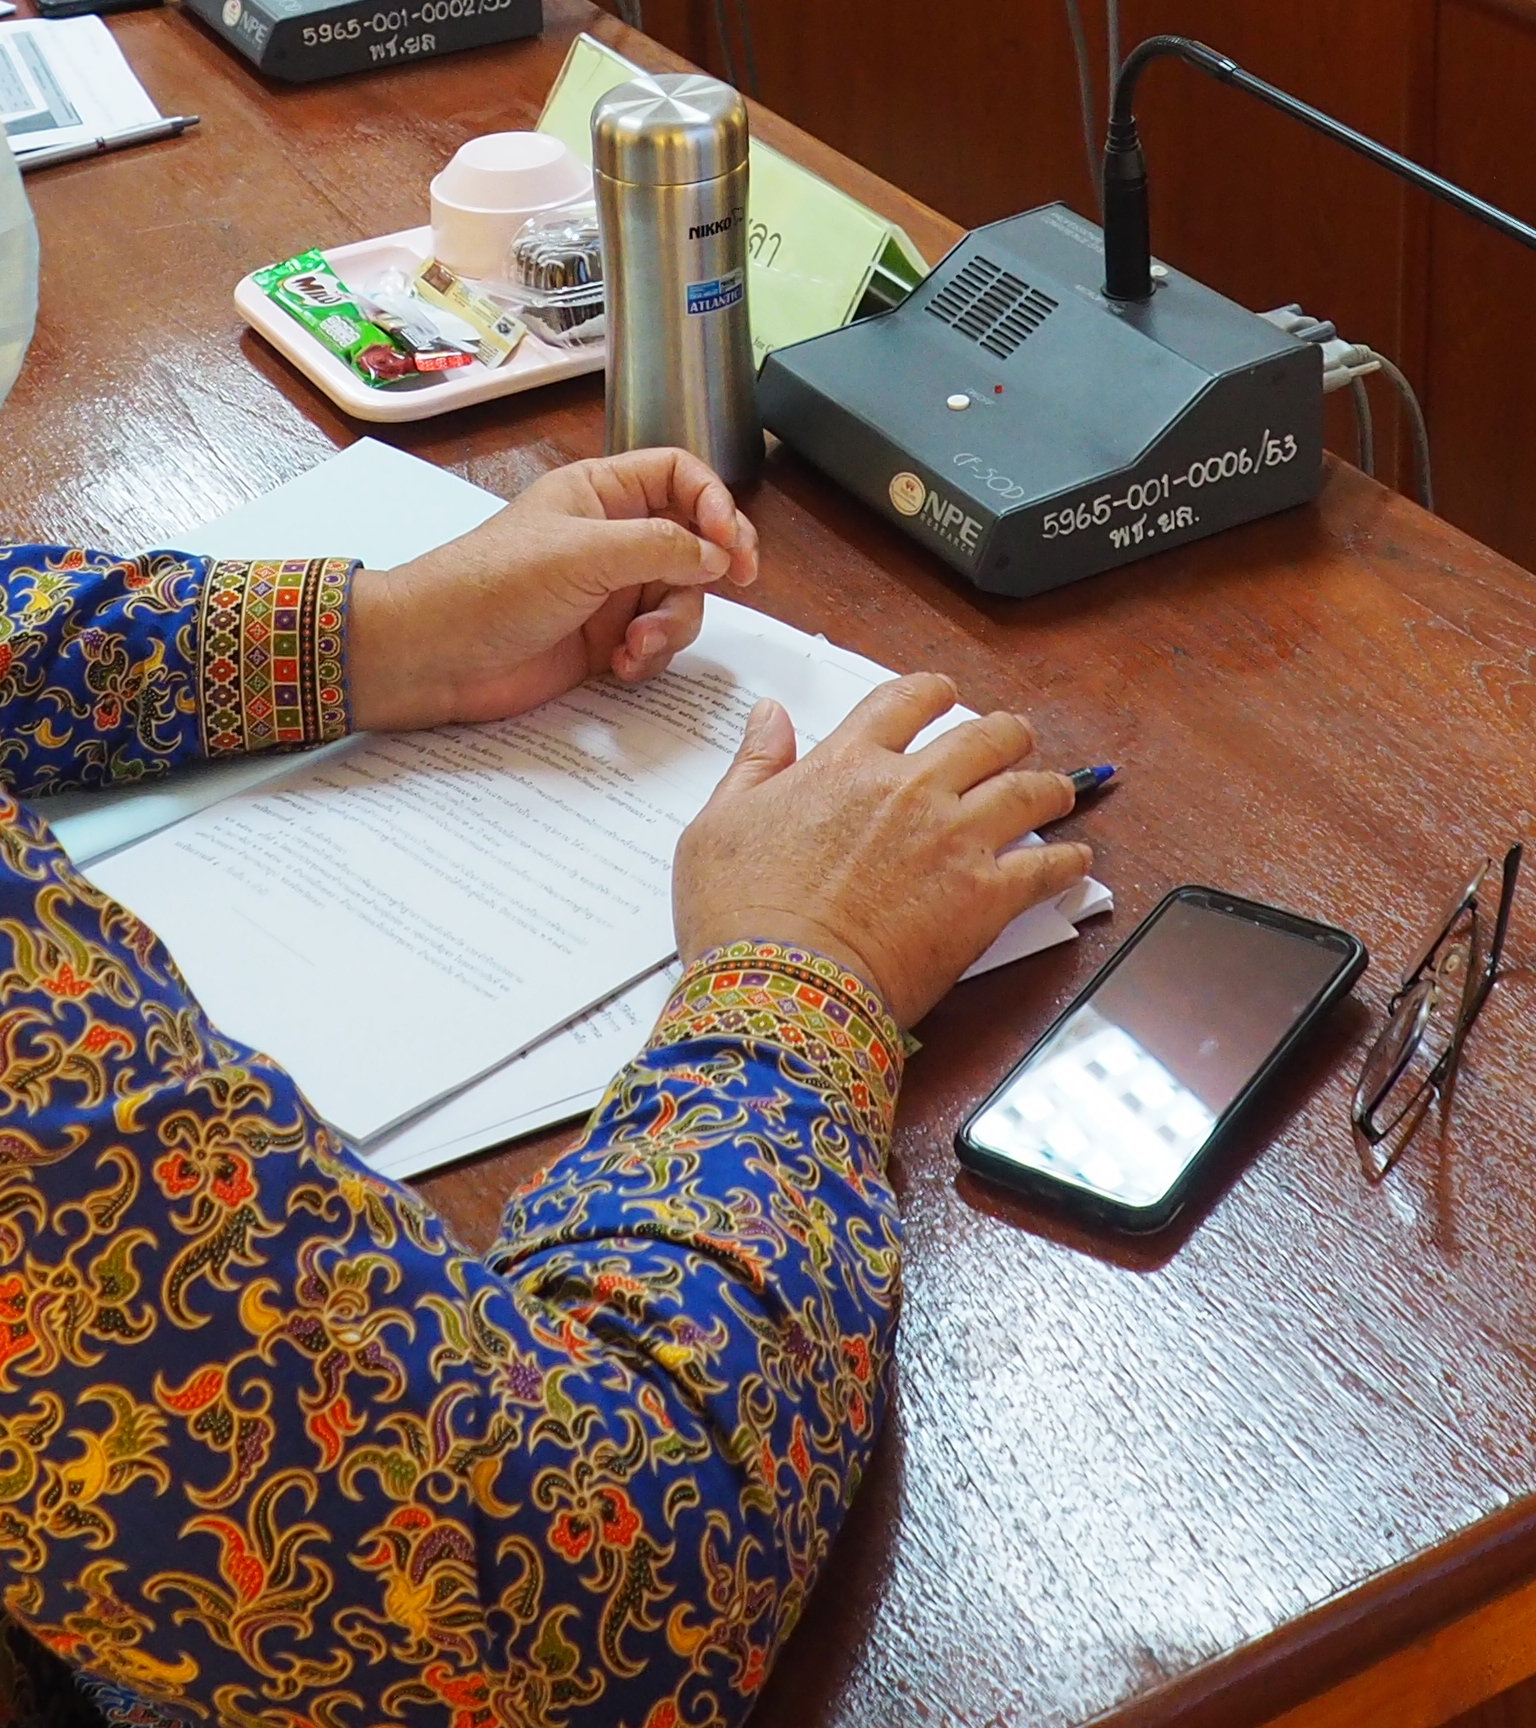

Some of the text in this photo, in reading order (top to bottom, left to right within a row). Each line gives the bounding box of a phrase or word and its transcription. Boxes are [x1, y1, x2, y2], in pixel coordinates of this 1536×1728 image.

[240, 11, 268, 43] NPE
[689, 217, 732, 240] NIKKO
[690, 287, 740, 312] ATLANTIC
[1042, 429, 1298, 539] 5965-001-0006/53
[919, 513, 975, 556] RESEARCH
[923, 490, 983, 549] NPE
